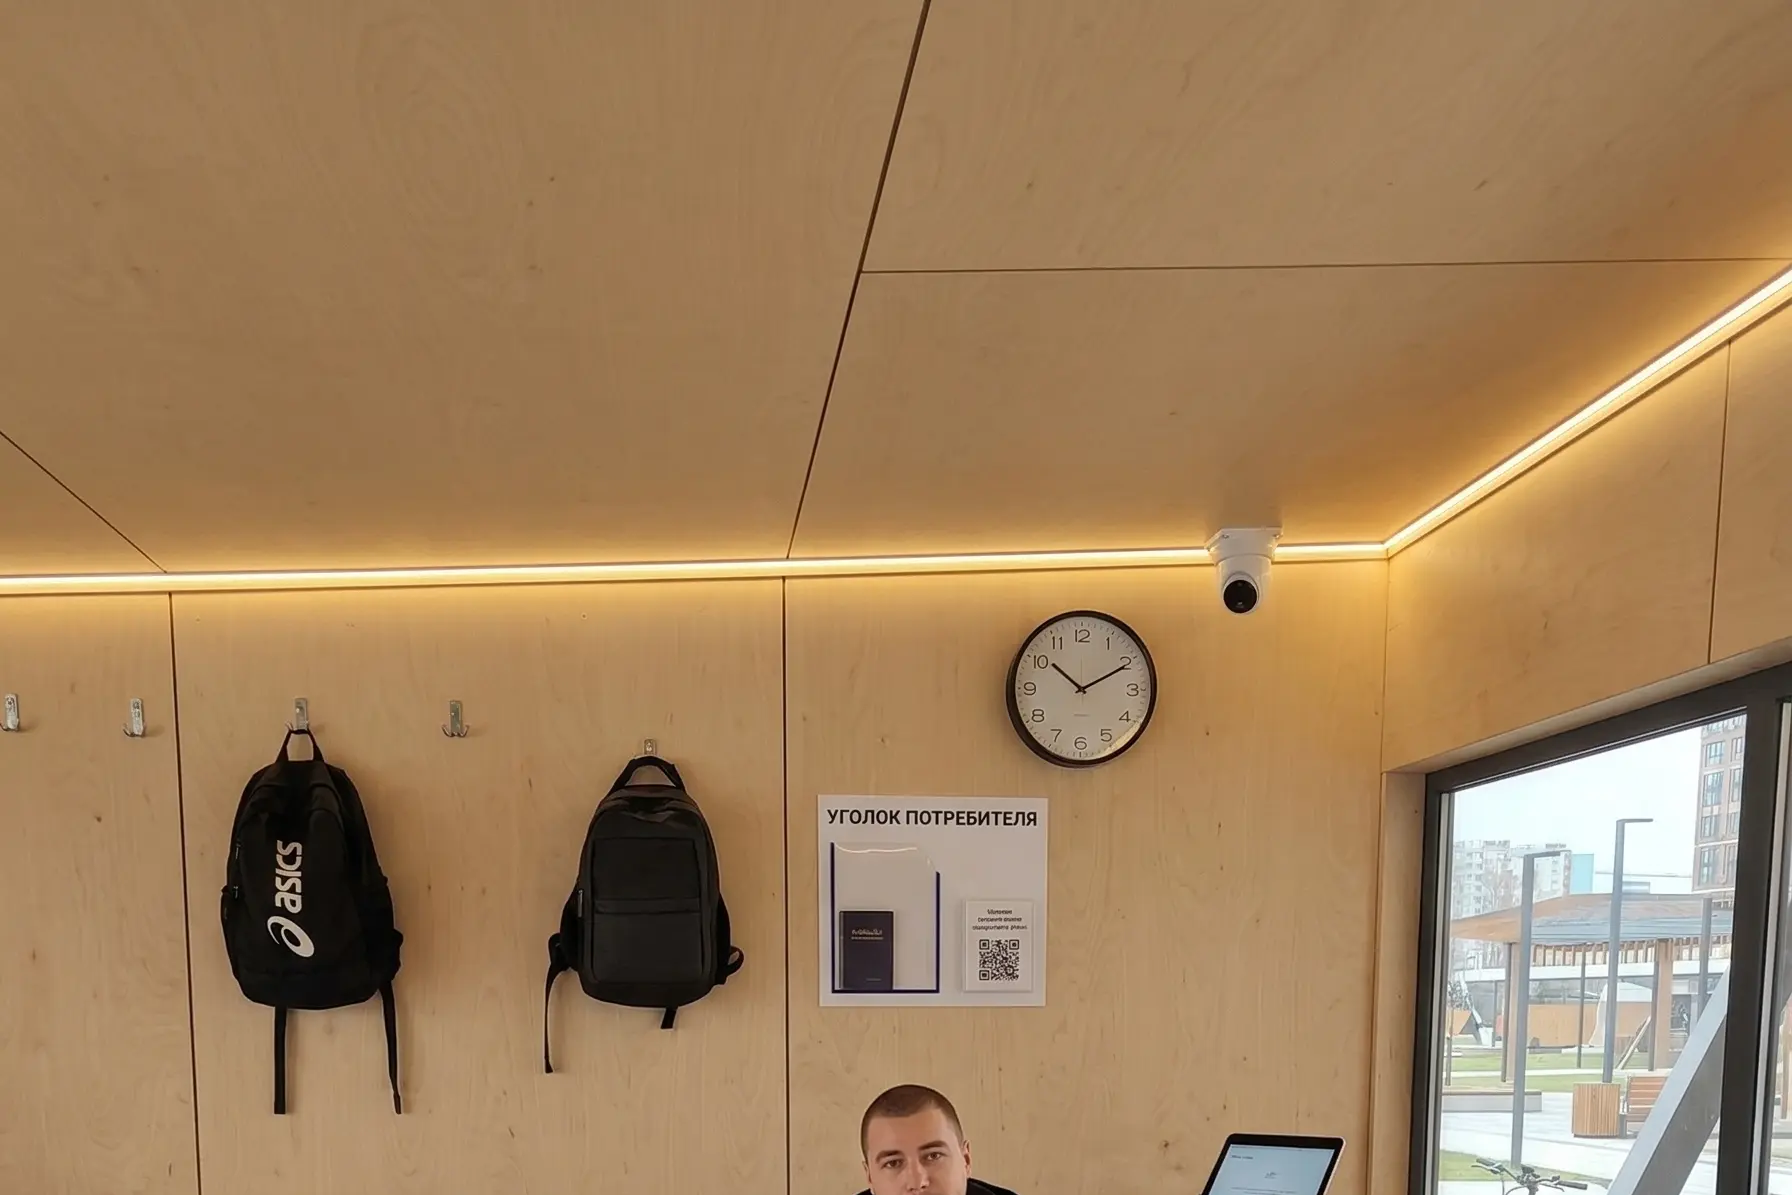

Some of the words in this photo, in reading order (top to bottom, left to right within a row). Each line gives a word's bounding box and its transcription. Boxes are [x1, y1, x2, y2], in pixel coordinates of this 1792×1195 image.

[1051, 636, 1063, 650] 11
[1074, 629, 1091, 643] 12
[1033, 654, 1049, 669] 10
[1119, 656, 1132, 670] 2
[1023, 681, 1037, 696] 9
[1126, 683, 1139, 697] 3
[1031, 708, 1045, 723] 8
[1118, 710, 1131, 723] 4
[1050, 728, 1062, 743] 7
[1100, 728, 1113, 742] 5
[1074, 736, 1088, 750] 6
[827, 809, 901, 825] УГОЛОК
[905, 810, 1037, 826] ПОТРЕБИТЕЛЯ
[274, 839, 303, 914] asics
